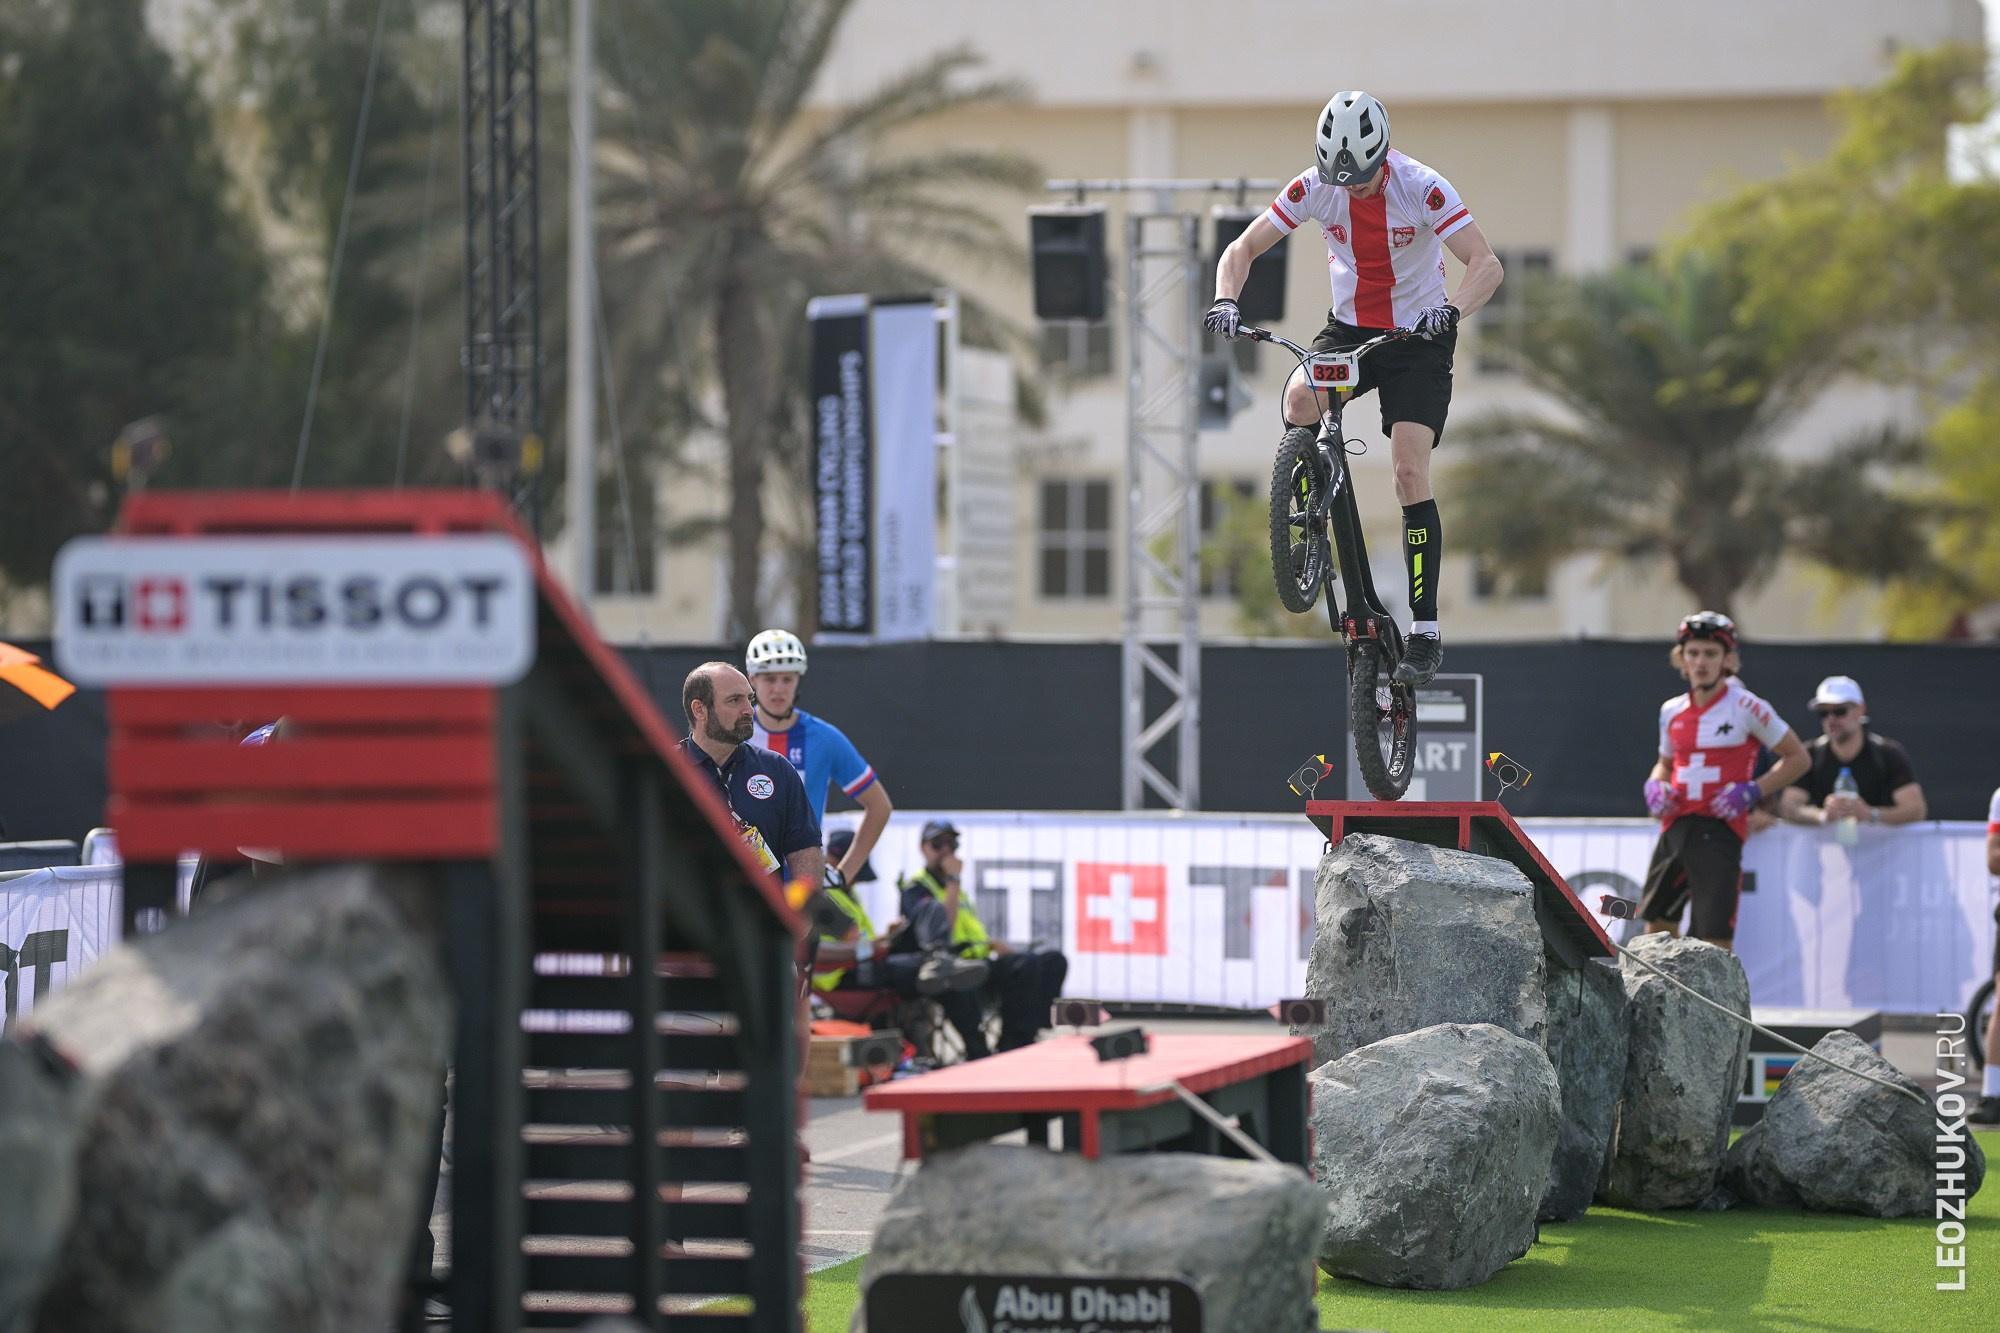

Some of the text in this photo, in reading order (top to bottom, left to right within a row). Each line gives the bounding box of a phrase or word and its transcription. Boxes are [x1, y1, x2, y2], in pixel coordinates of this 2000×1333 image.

[1316, 366, 1347, 381] 328
[203, 574, 507, 630] TISSOT
[993, 1285, 1171, 1322] Abu Dhabi
